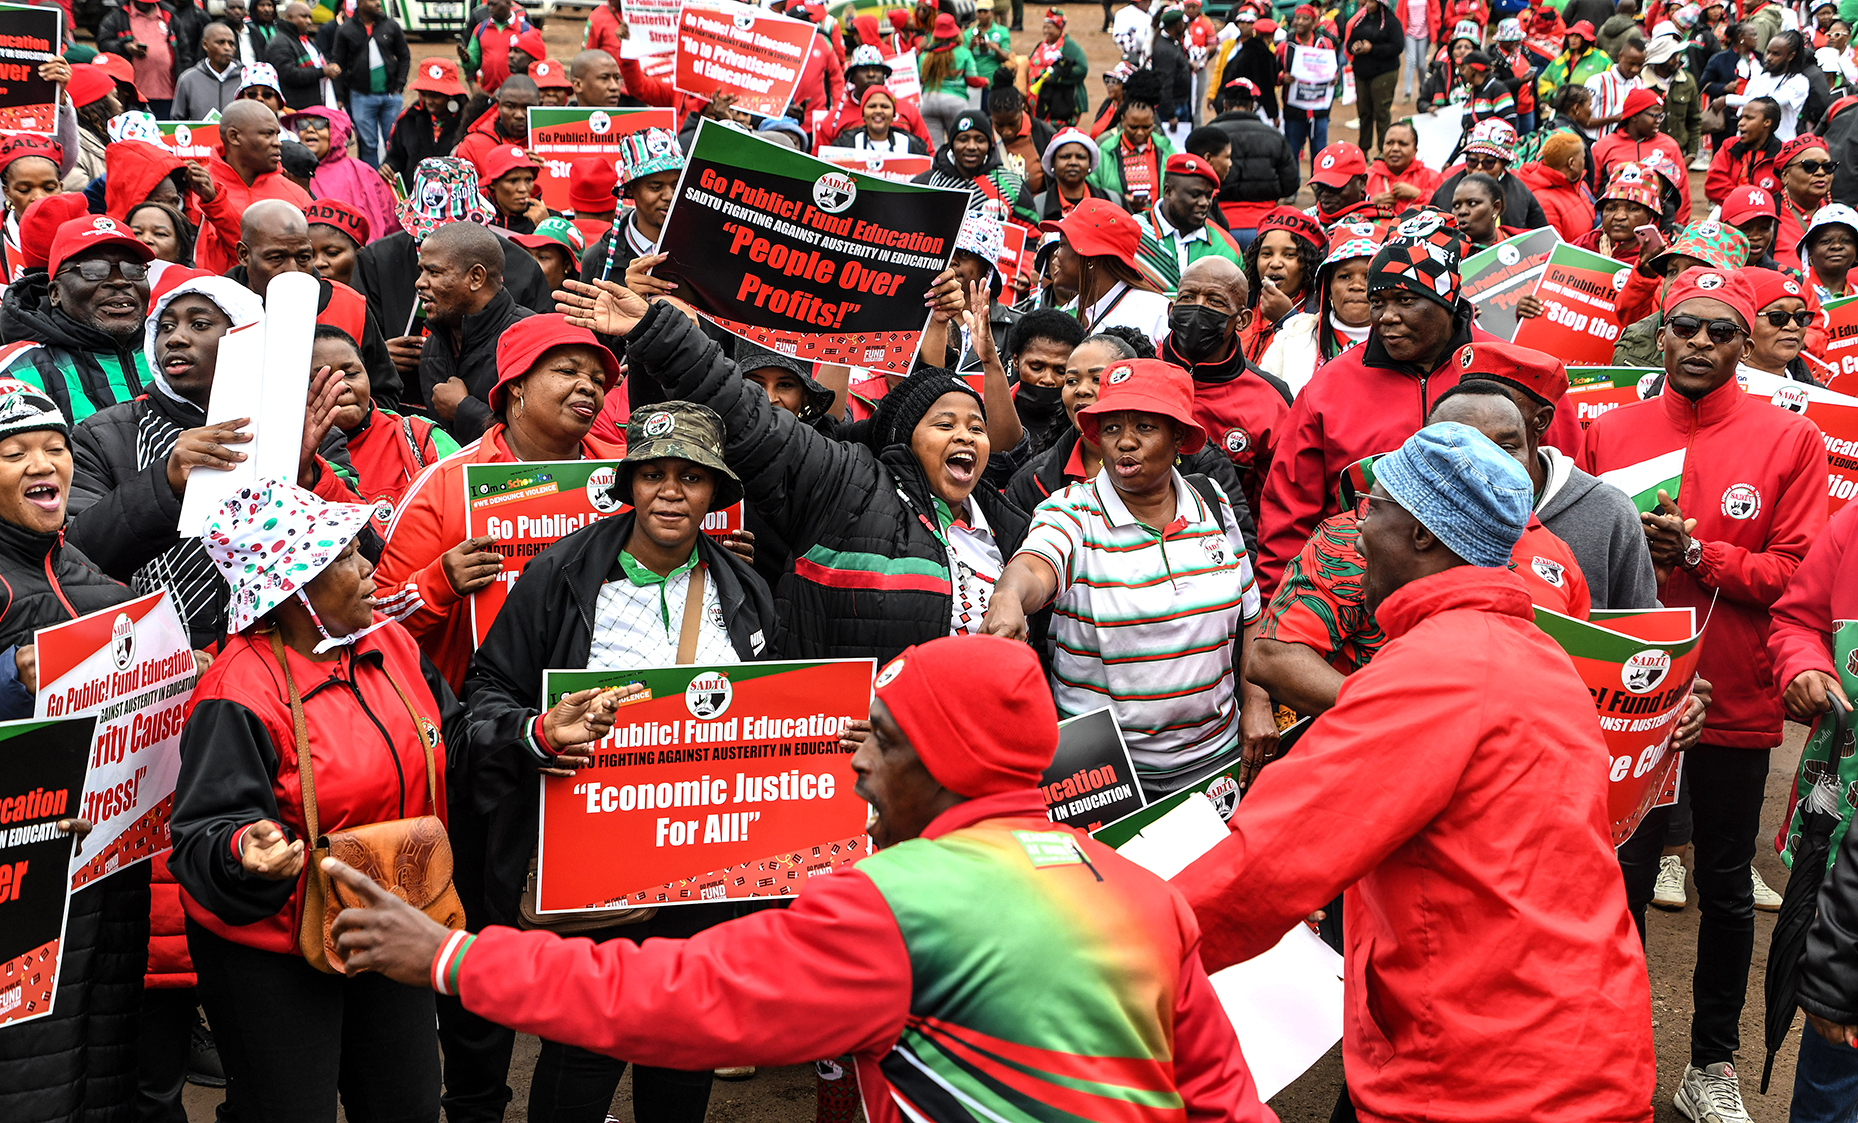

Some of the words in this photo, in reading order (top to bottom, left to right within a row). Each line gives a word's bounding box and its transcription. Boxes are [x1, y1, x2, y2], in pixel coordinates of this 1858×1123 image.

[685, 12, 698, 26] Go
[729, 24, 753, 43] Fund
[753, 32, 802, 58] Education
[681, 35, 700, 54] “No
[700, 41, 713, 58] to
[713, 44, 796, 83] Privatisation
[692, 59, 705, 74] of
[538, 132, 552, 143] Go
[553, 132, 588, 144] Public!
[590, 132, 614, 144] Fund
[819, 174, 856, 193] SADTU
[700, 167, 724, 193] Go
[729, 178, 804, 220] Public!
[802, 204, 852, 237] Fund
[852, 220, 945, 255] Education
[685, 187, 723, 211] SADTU
[722, 200, 774, 230] FIGHTING
[773, 218, 822, 246] AGAINST
[820, 236, 880, 260] AUSTERITY
[878, 250, 891, 262] IN
[890, 252, 945, 272] EDUCATION
[1265, 213, 1319, 236] SADTU
[722, 221, 836, 282] “People
[839, 260, 906, 298] Over
[1551, 269, 1567, 284] Go
[1568, 274, 1607, 298] Public!
[735, 272, 861, 330] Profits!”
[1544, 299, 1588, 332] “Stop
[1586, 316, 1619, 341] the
[774, 341, 797, 353] FUND
[864, 348, 886, 359] FUND
[1777, 389, 1807, 403] SADTU
[473, 498, 488, 510] #WE
[488, 491, 525, 507] DENOUNCE
[524, 484, 557, 499] VIOLENCE
[1730, 492, 1754, 503] SADTU
[486, 515, 515, 541] Go
[113, 621, 132, 638] SADTU
[1630, 654, 1670, 668] SADTU
[47, 692, 65, 718] Go
[65, 674, 110, 716] Public!
[111, 666, 140, 698] Fund
[141, 648, 195, 688] Education
[690, 679, 728, 693] SADTU
[124, 691, 160, 715] AUSTERITY
[158, 688, 166, 703] IN
[1607, 688, 1664, 715] Fund
[600, 720, 680, 750] Public!
[684, 717, 738, 744] Fund
[742, 713, 852, 740] Education
[598, 751, 655, 769] FIGHTING
[658, 749, 709, 766] AGAINST
[712, 744, 777, 763] AUSTERITY
[779, 743, 792, 757] IN
[573, 775, 728, 814] “Economic
[733, 769, 836, 804] Justice
[1206, 778, 1234, 801] SADTU
[1054, 804, 1070, 822] IN
[1069, 784, 1133, 817] EDUCATION
[655, 817, 699, 848] For
[703, 811, 761, 844] All!”
[700, 885, 727, 901] FUND
